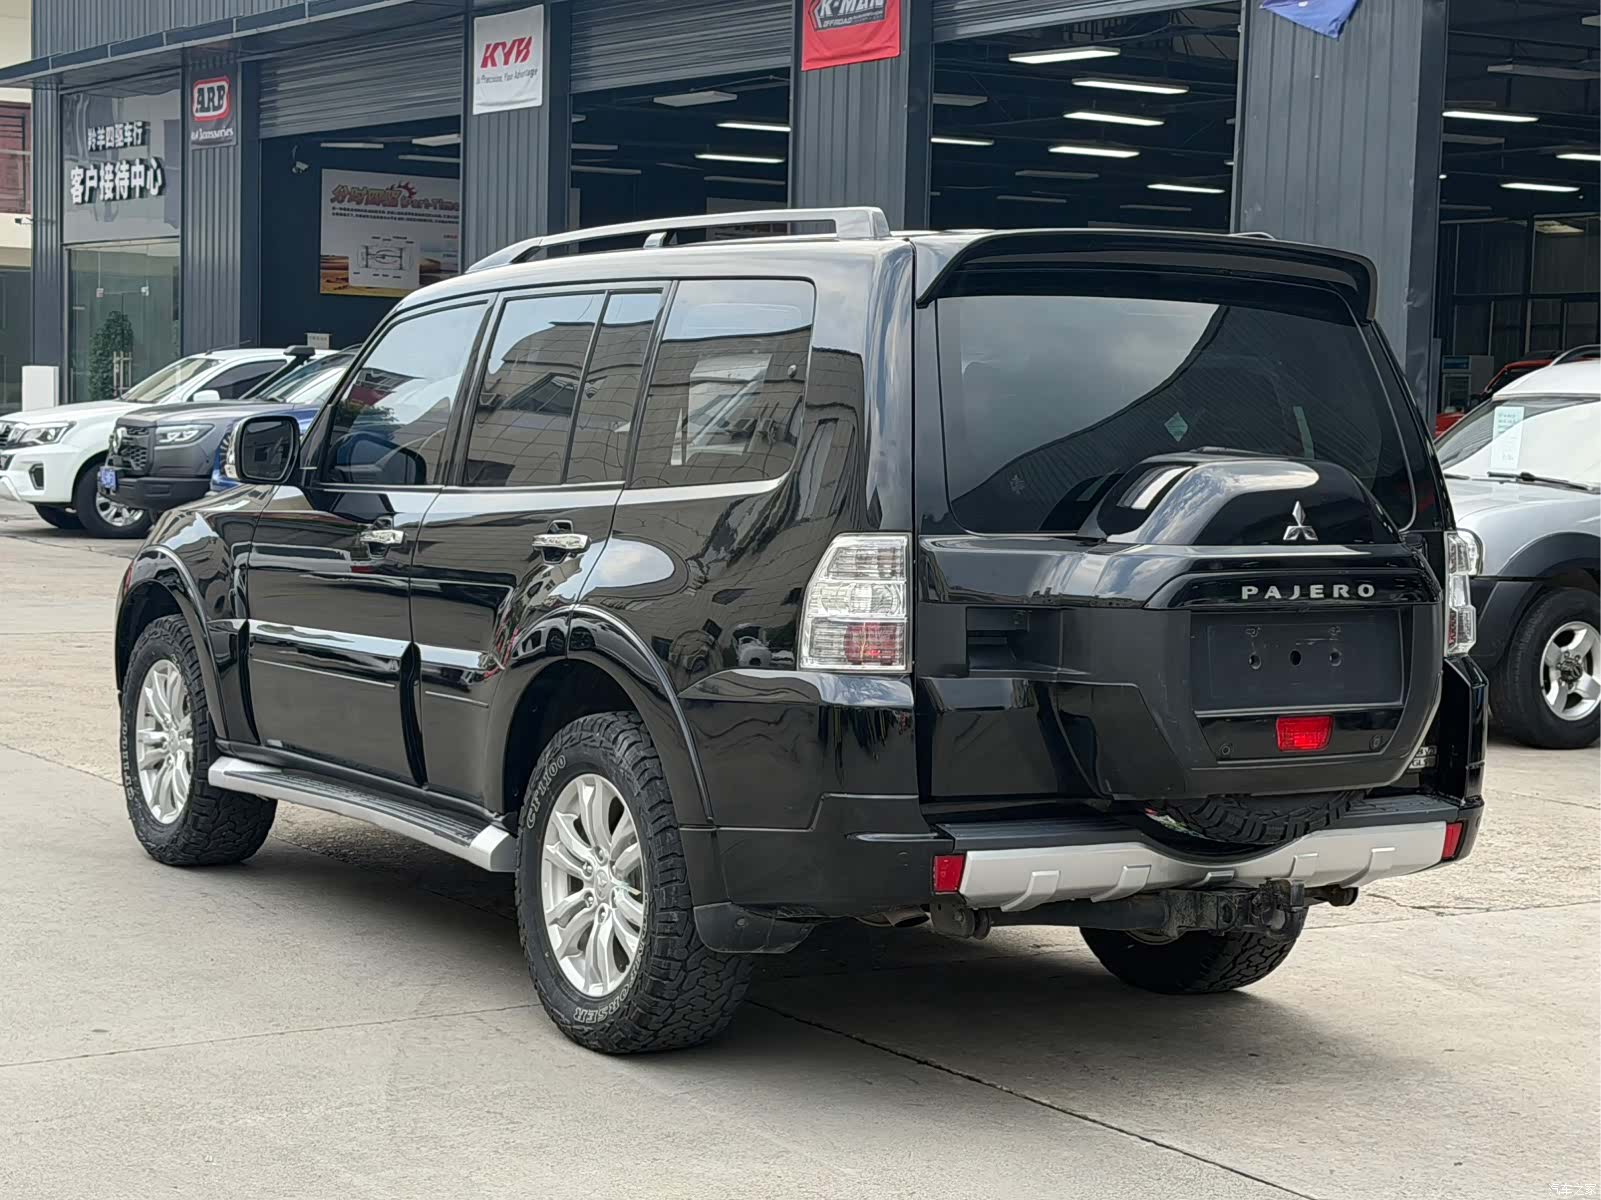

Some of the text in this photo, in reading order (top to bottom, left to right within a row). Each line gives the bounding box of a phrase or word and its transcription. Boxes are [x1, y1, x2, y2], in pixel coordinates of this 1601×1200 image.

[480, 35, 533, 68] KYB
[195, 85, 227, 113] ARB
[70, 157, 163, 205] 客户接待中心
[1241, 583, 1375, 600] PAJERO
